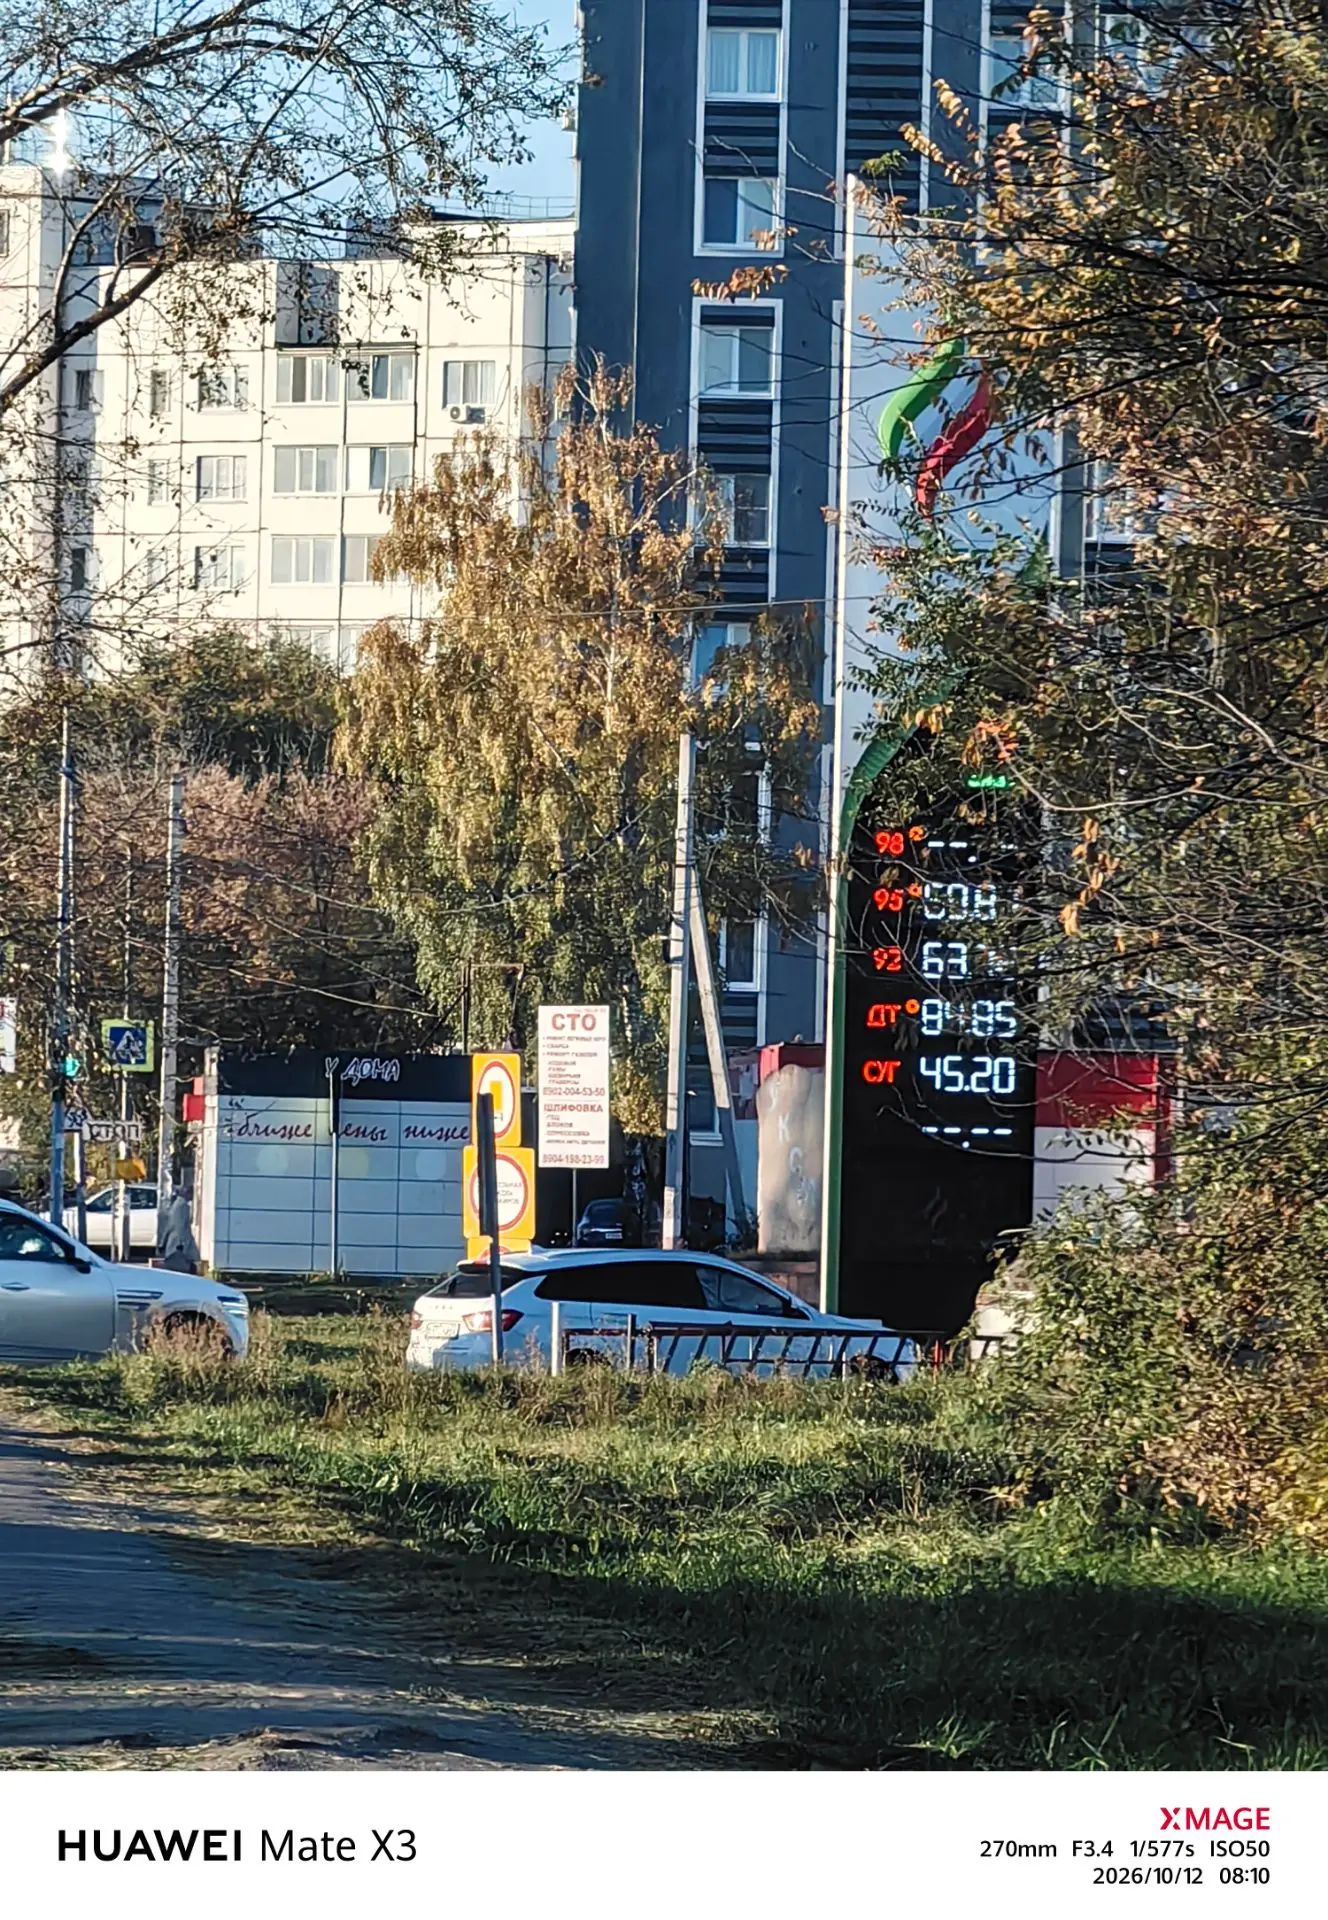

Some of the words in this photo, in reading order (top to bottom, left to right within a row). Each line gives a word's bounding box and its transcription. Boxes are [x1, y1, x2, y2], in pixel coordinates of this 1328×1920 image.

[876, 832, 904, 855] 98
[873, 888, 904, 911] 95
[873, 946, 902, 970] 92
[551, 1013, 597, 1032] СТО
[867, 1003, 902, 1028] ДТ
[340, 1057, 401, 1087] ДОМА
[862, 1059, 902, 1084] СУГ
[919, 1055, 1017, 1094] 45.20
[543, 1104, 604, 1113] ШЛИФОВКА
[328, 1122, 387, 1142] ены
[403, 1124, 470, 1142] ниже
